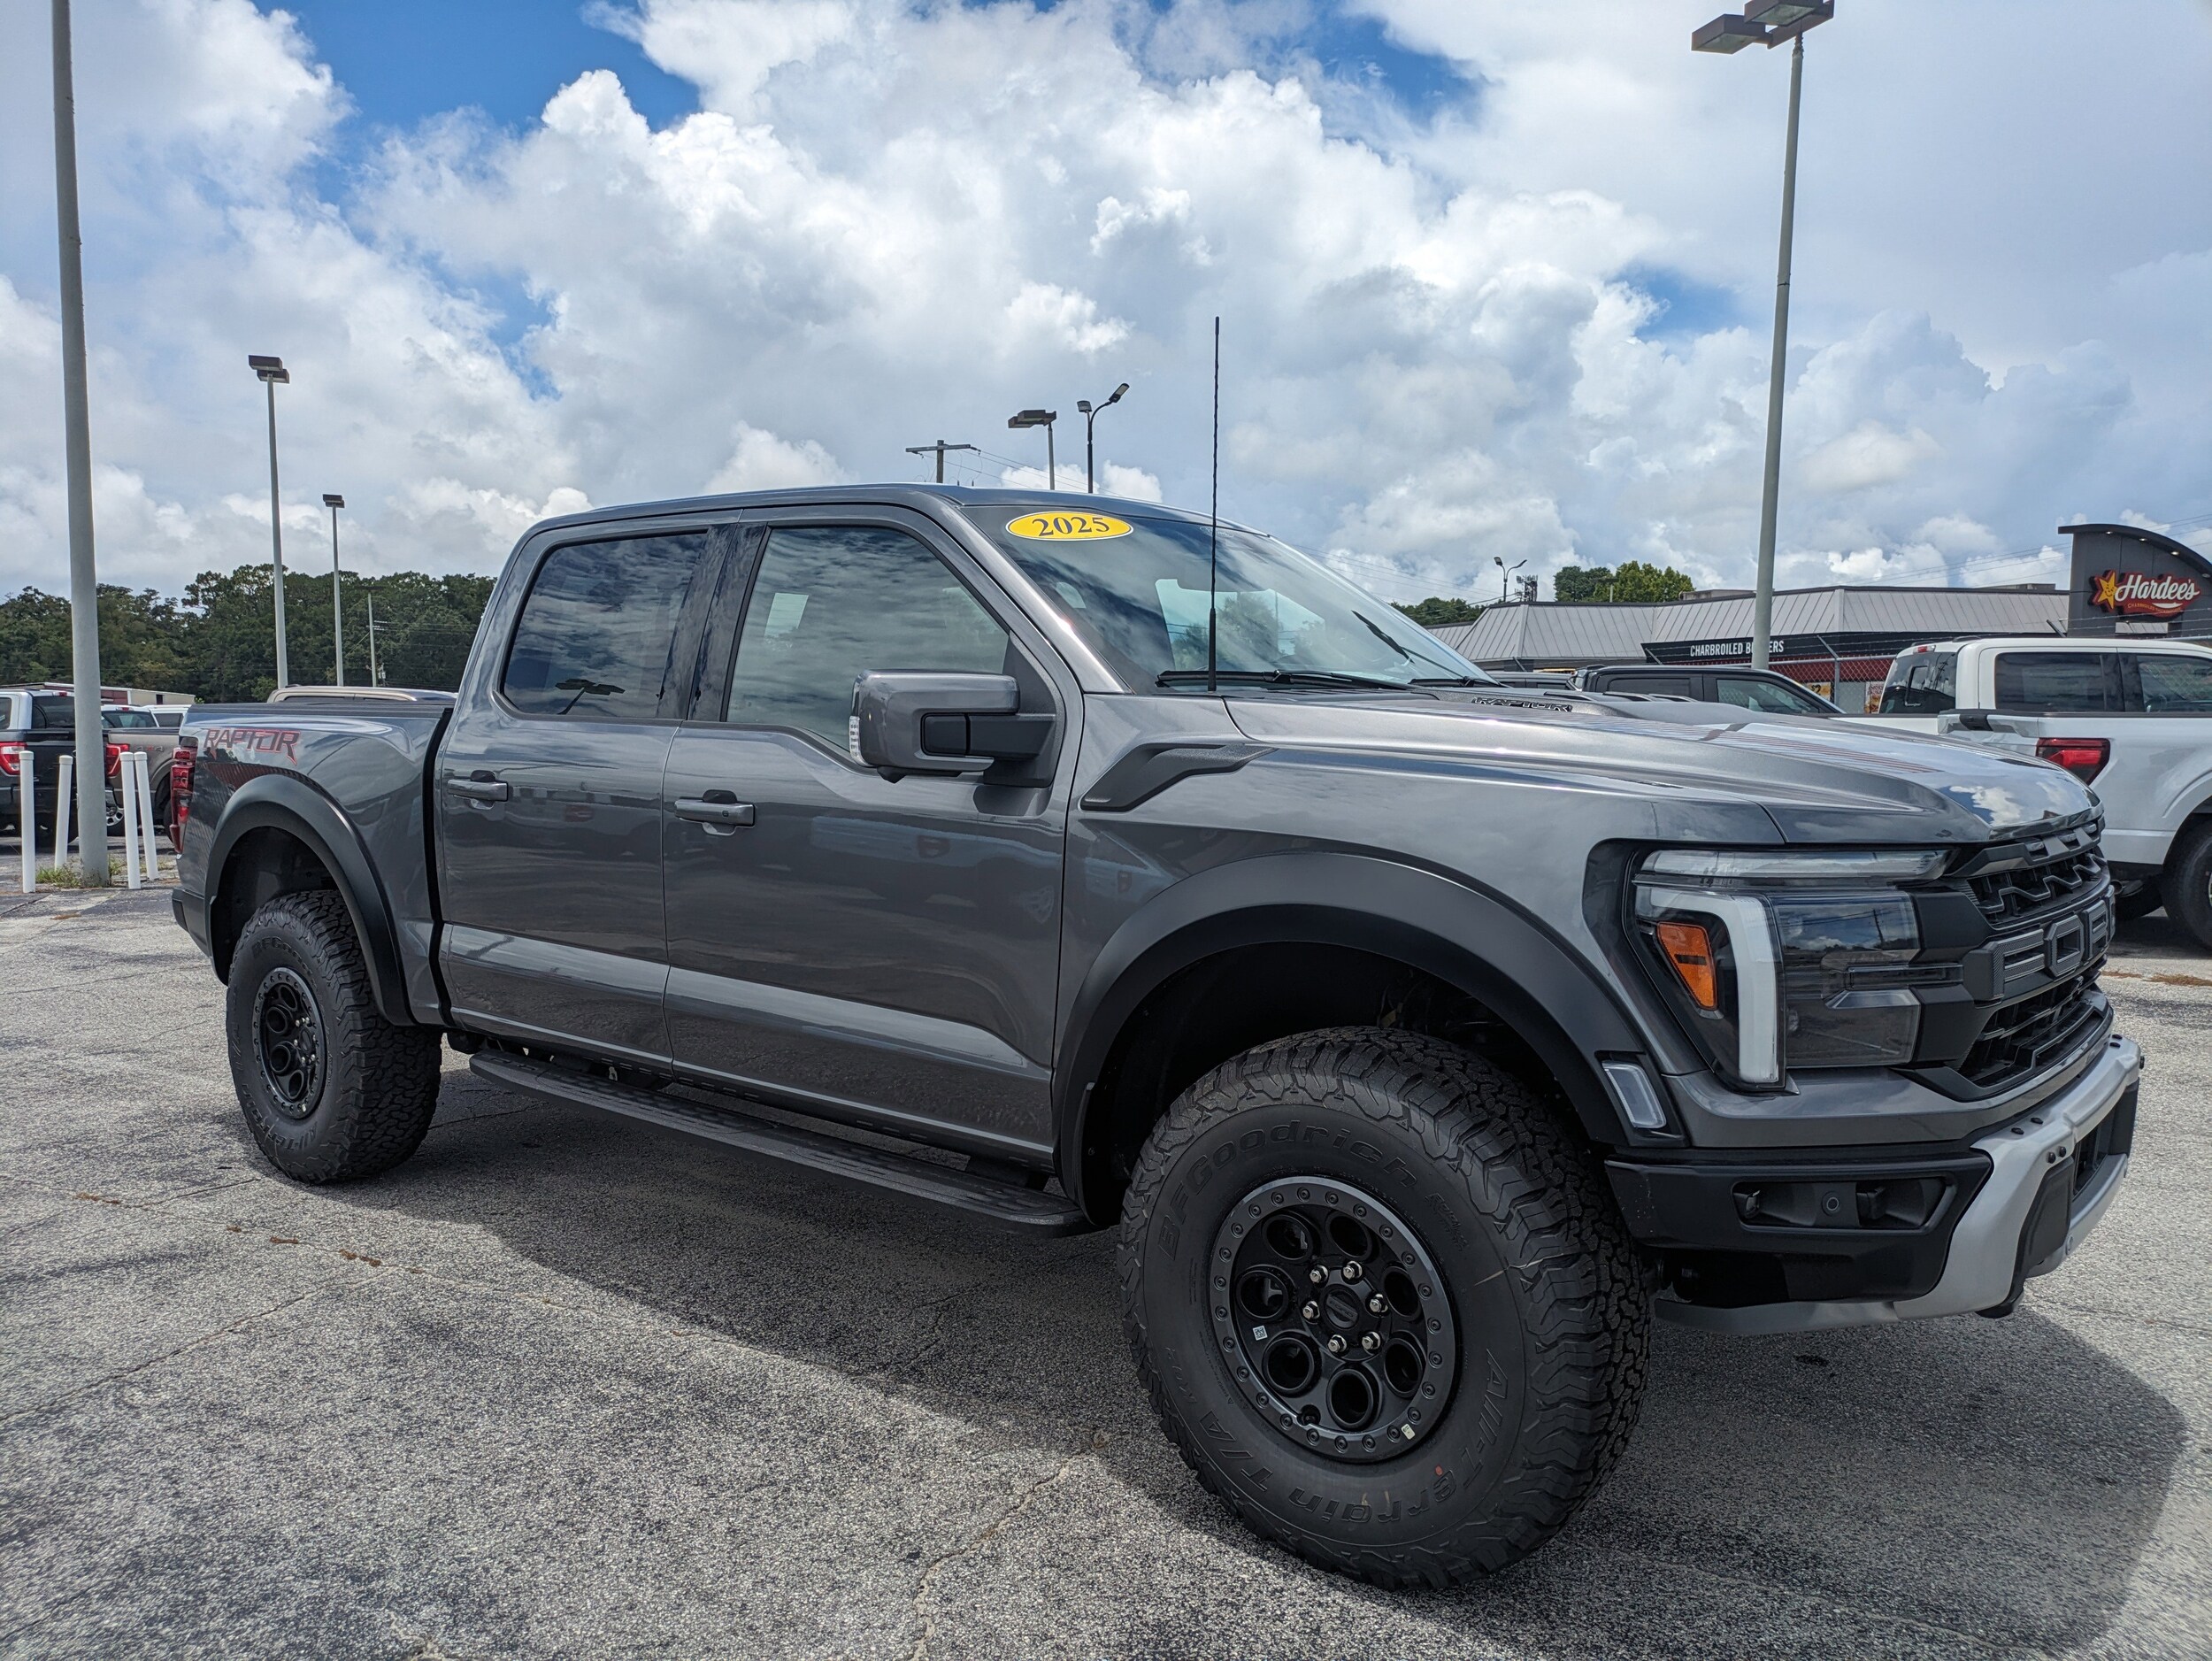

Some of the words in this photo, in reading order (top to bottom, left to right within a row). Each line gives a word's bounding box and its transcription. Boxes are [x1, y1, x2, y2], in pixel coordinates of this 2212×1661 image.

[1032, 516, 1110, 537] 2025
[2115, 574, 2200, 602] Hardee's
[1690, 642, 1743, 657] CHARBROILED
[1745, 640, 1785, 654] BERS
[1471, 696, 1574, 712] RAPTOR
[203, 727, 301, 766] RAPTOR
[1157, 1119, 1418, 1261] BFGoodrich
[1200, 1410, 1274, 1492] T/A
[1287, 1348, 1508, 1524] All-Terrain
